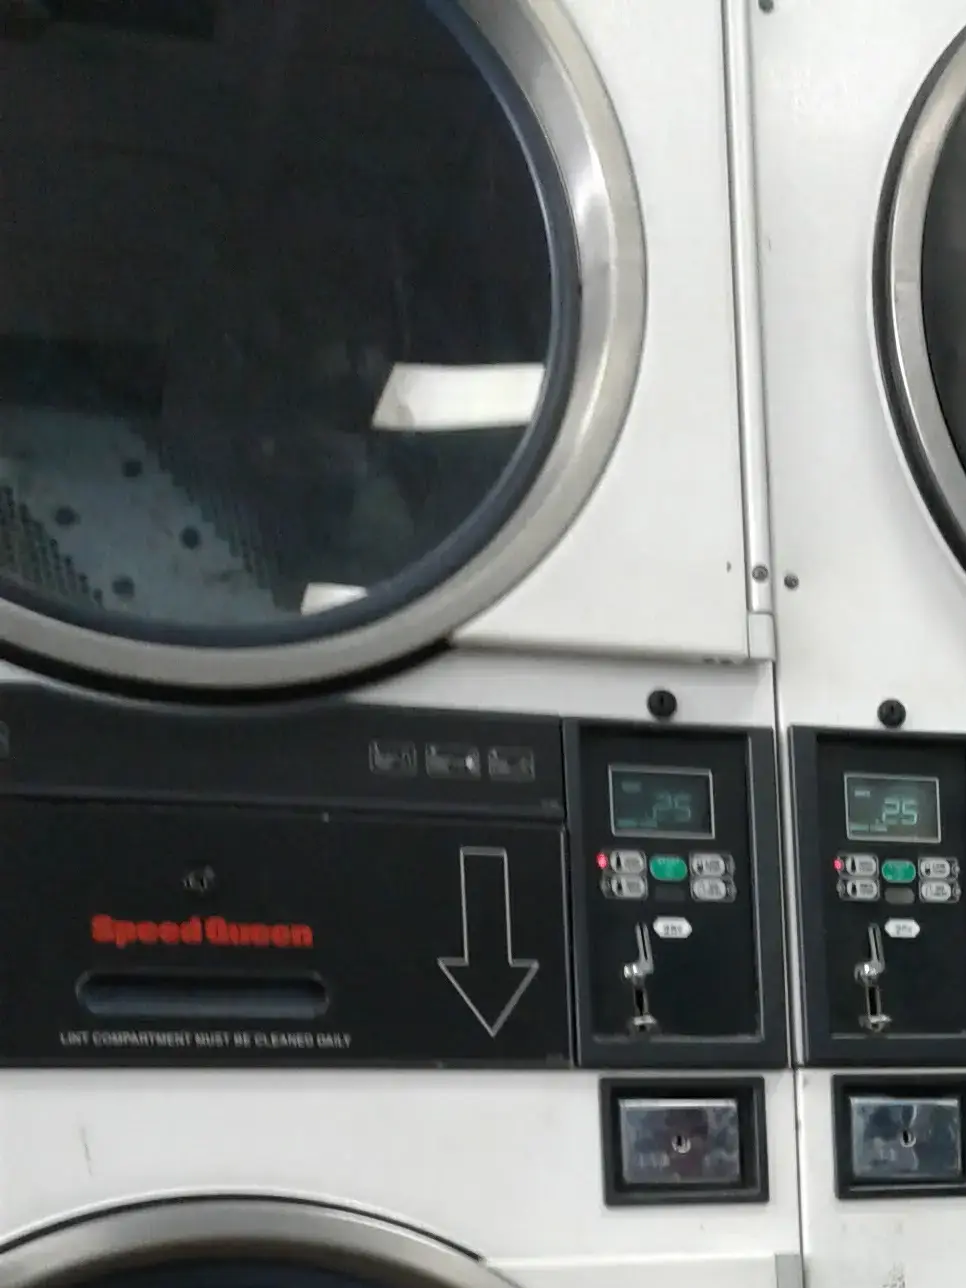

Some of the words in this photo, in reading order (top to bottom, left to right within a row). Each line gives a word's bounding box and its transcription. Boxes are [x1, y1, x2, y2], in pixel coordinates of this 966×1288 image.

[91, 914, 203, 949] Speed
[205, 915, 314, 947] Queen
[60, 1030, 89, 1047] LINT
[92, 1030, 191, 1047] COMPARTMENT
[196, 1031, 230, 1047] MUST
[234, 1032, 249, 1047] BE
[254, 1032, 313, 1048] CLEANED
[317, 1032, 351, 1049] DAILY
